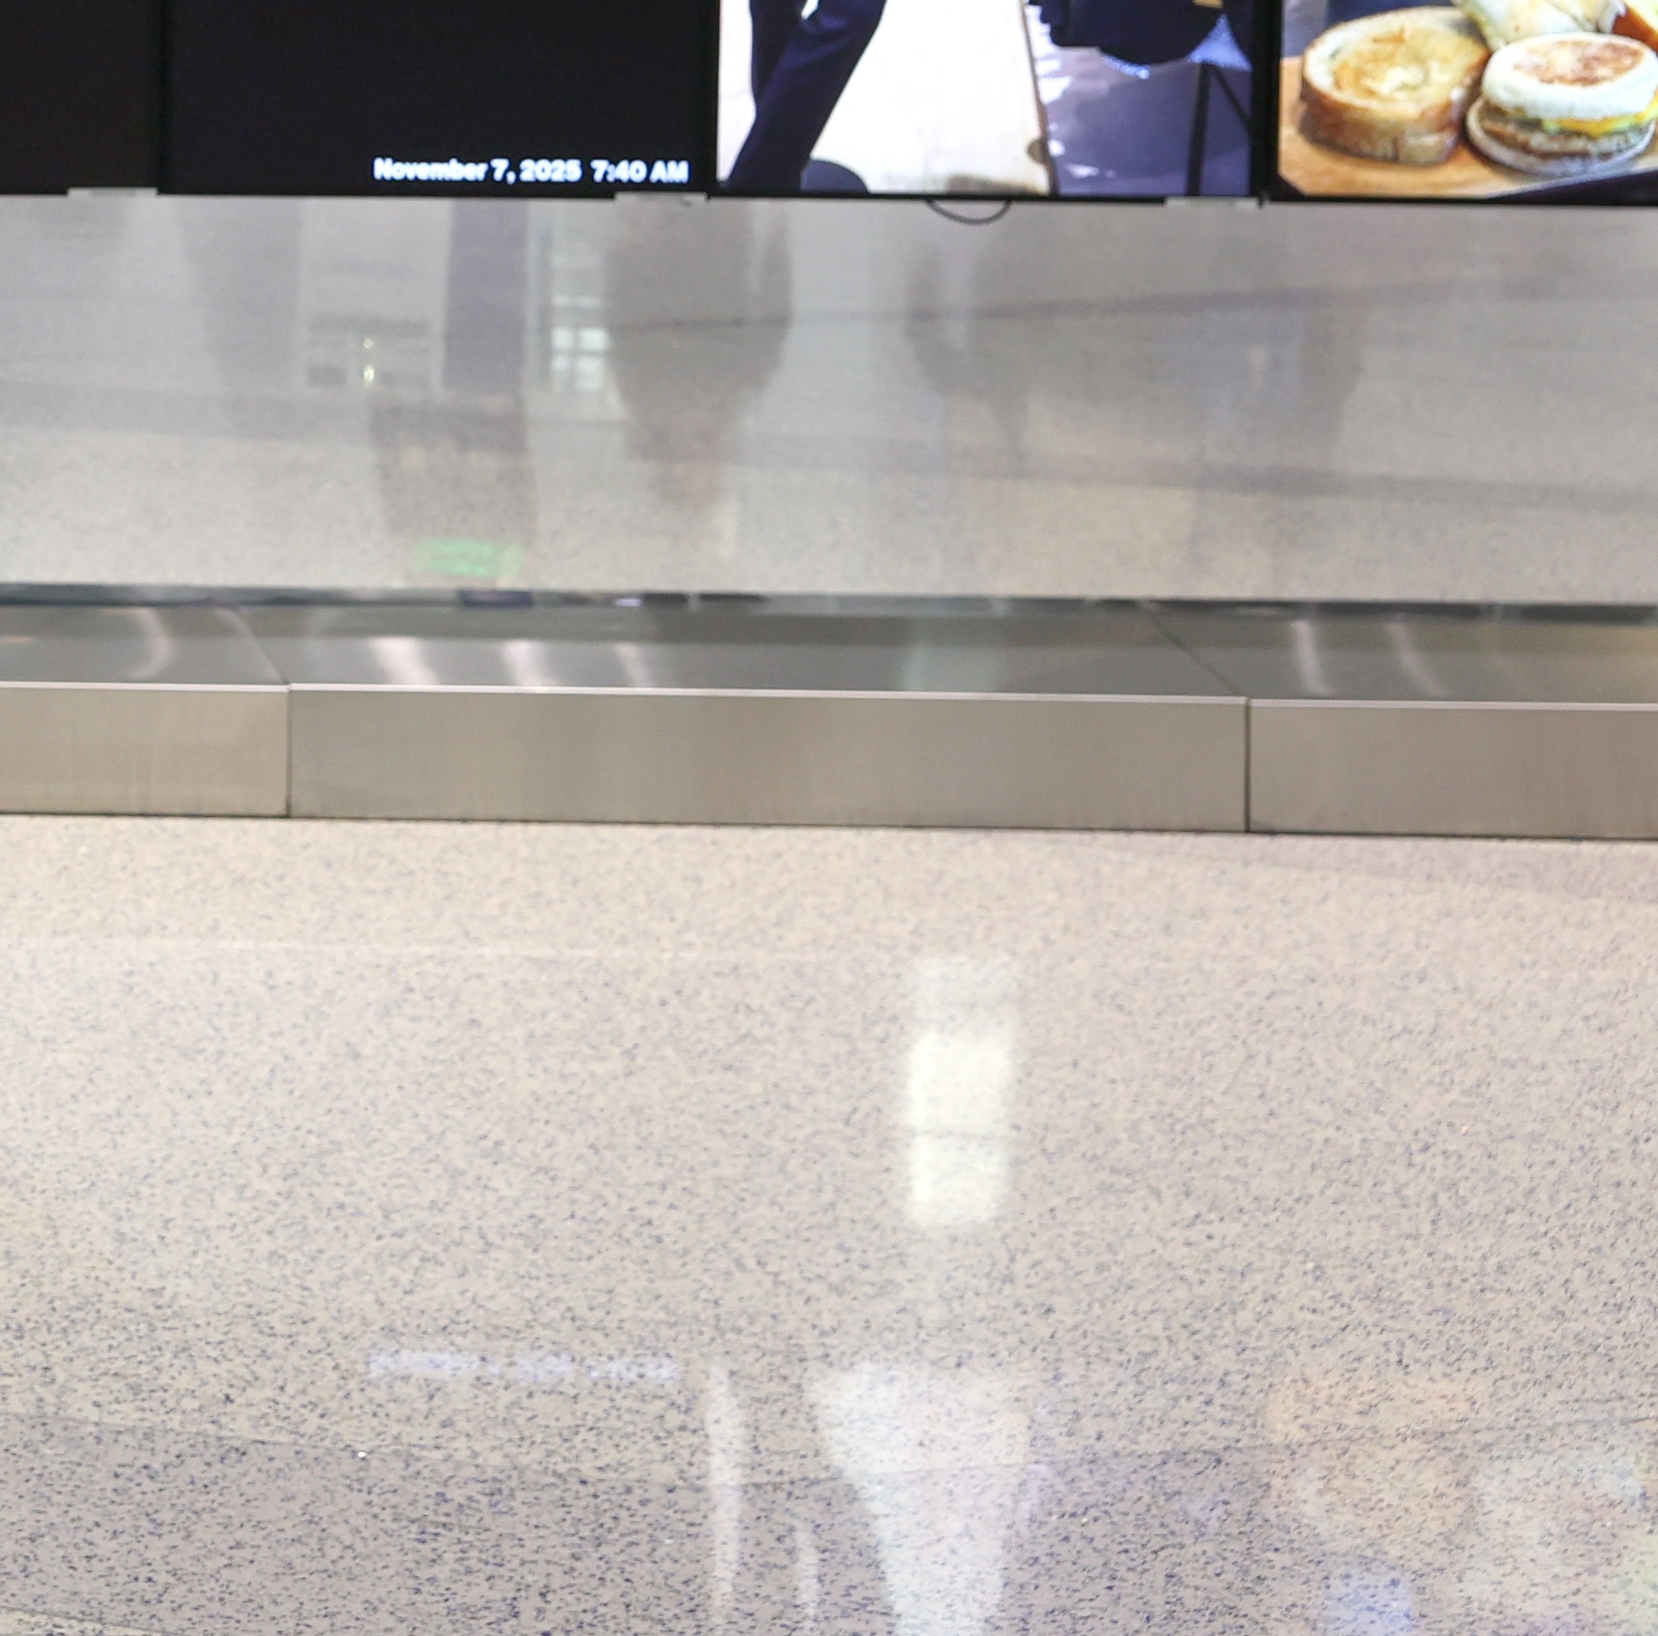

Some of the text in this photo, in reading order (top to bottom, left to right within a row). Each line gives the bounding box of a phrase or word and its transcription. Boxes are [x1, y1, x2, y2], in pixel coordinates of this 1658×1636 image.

[374, 158, 688, 184] November 7, 2025 7:40 AM
